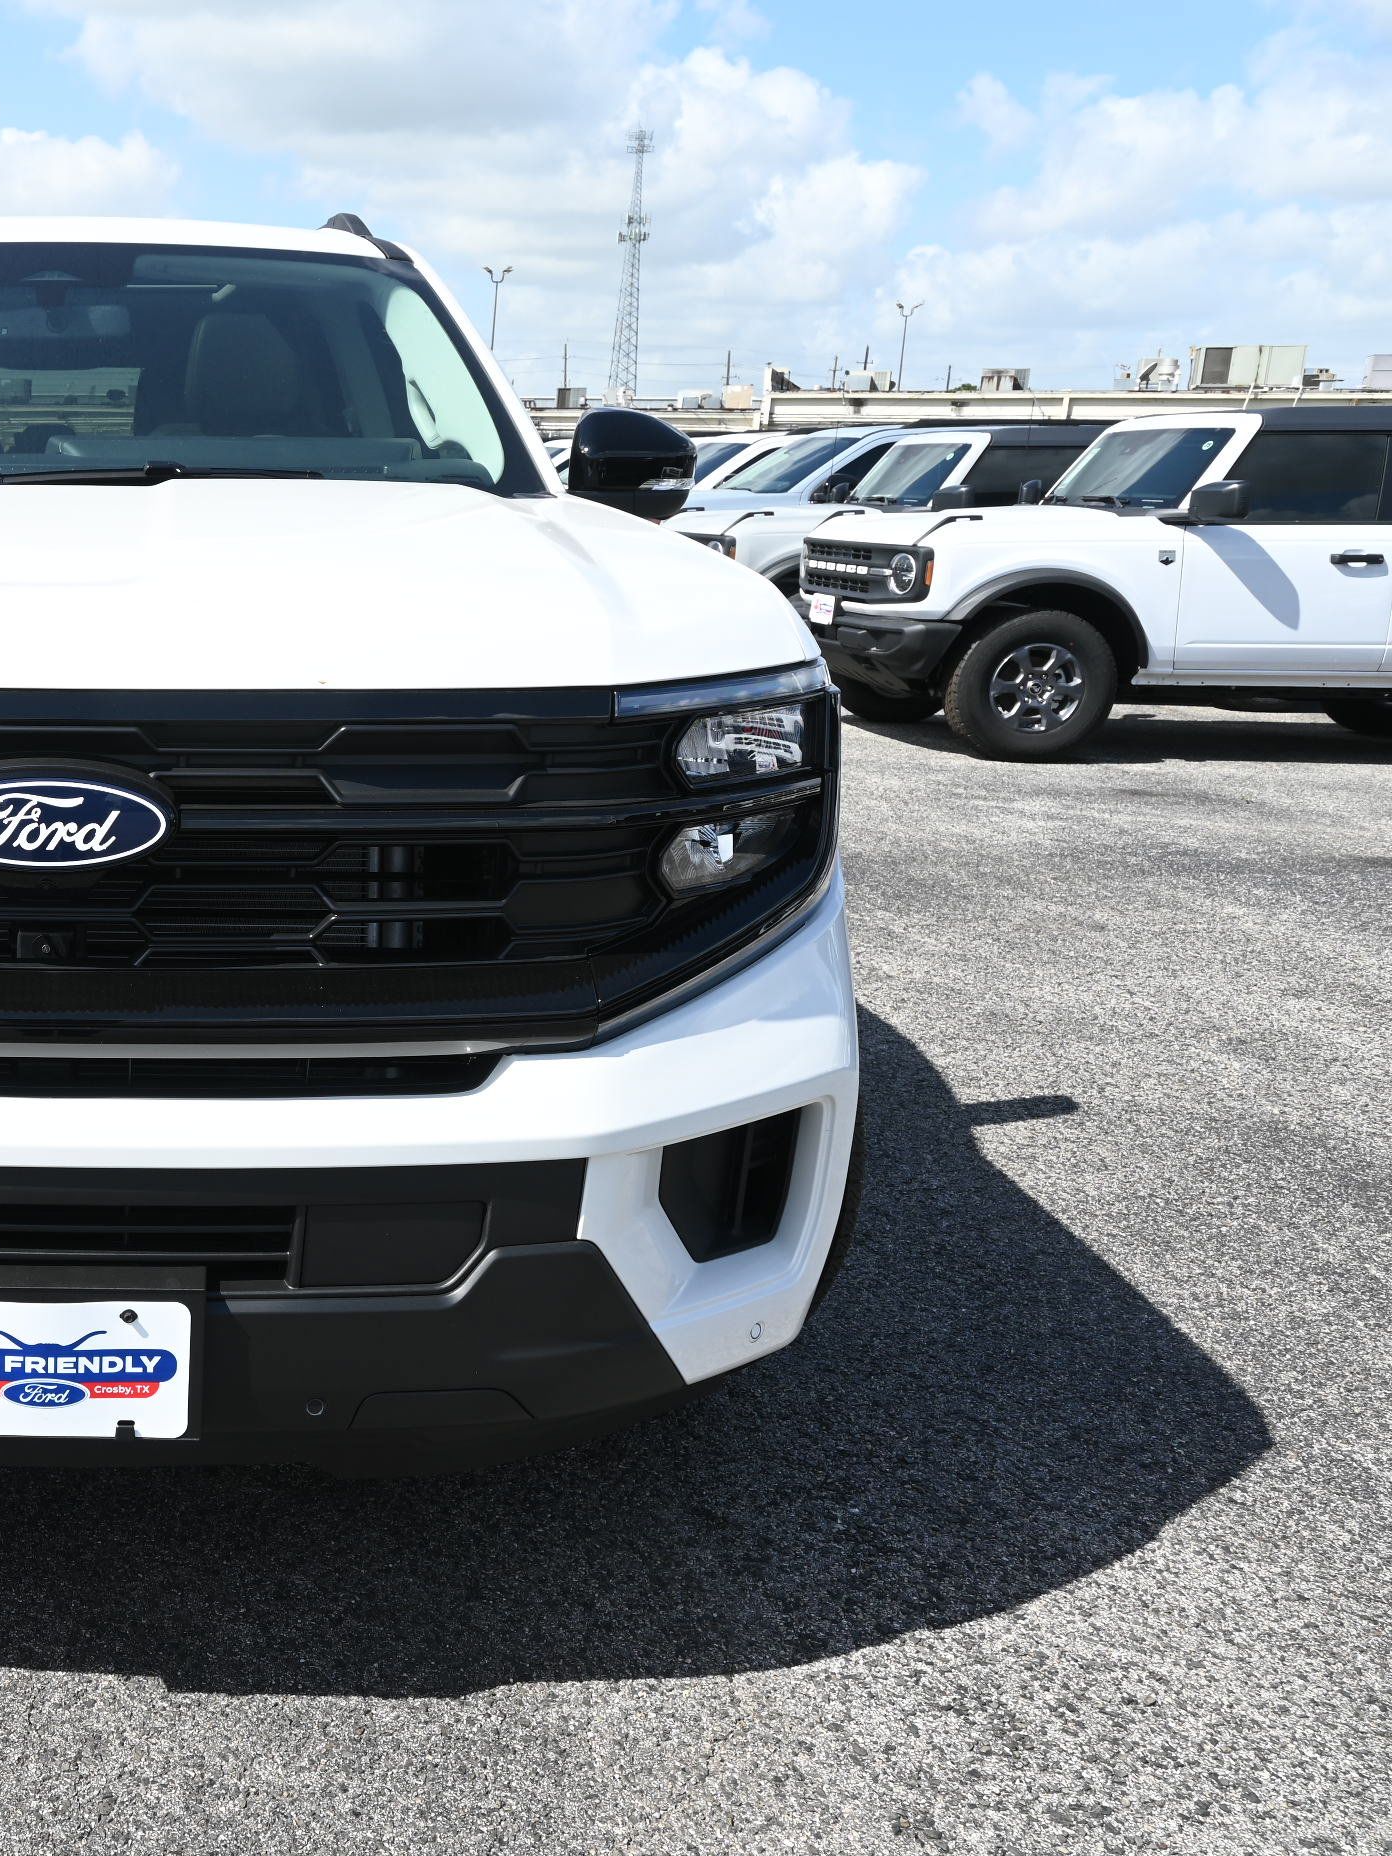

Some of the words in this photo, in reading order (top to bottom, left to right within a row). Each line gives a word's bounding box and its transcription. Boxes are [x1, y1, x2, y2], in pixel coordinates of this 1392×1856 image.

[3, 1355, 162, 1374] FRIENDLY
[19, 1383, 70, 1403] Ford
[93, 1384, 134, 1395] Crosby,
[135, 1385, 150, 1394] TX
